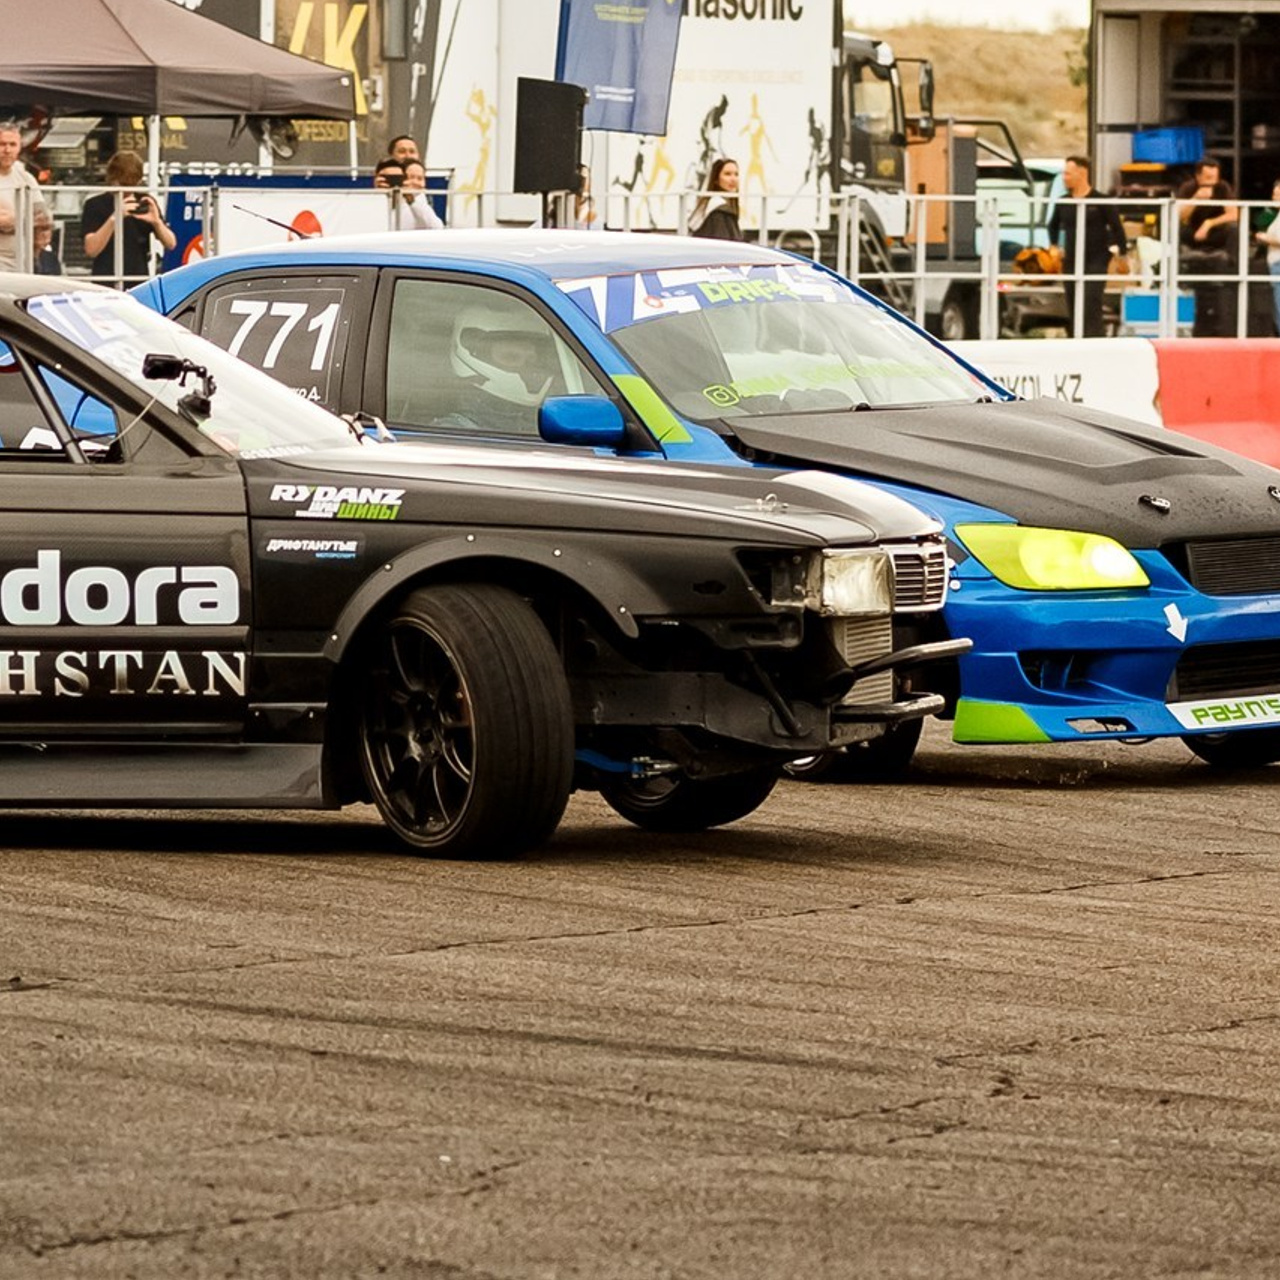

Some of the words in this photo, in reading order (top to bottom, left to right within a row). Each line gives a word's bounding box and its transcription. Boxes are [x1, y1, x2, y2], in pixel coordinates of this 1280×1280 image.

[228, 300, 340, 371] 771
[270, 484, 406, 506] RYDANZ
[336, 502, 400, 520] ШИНЫ
